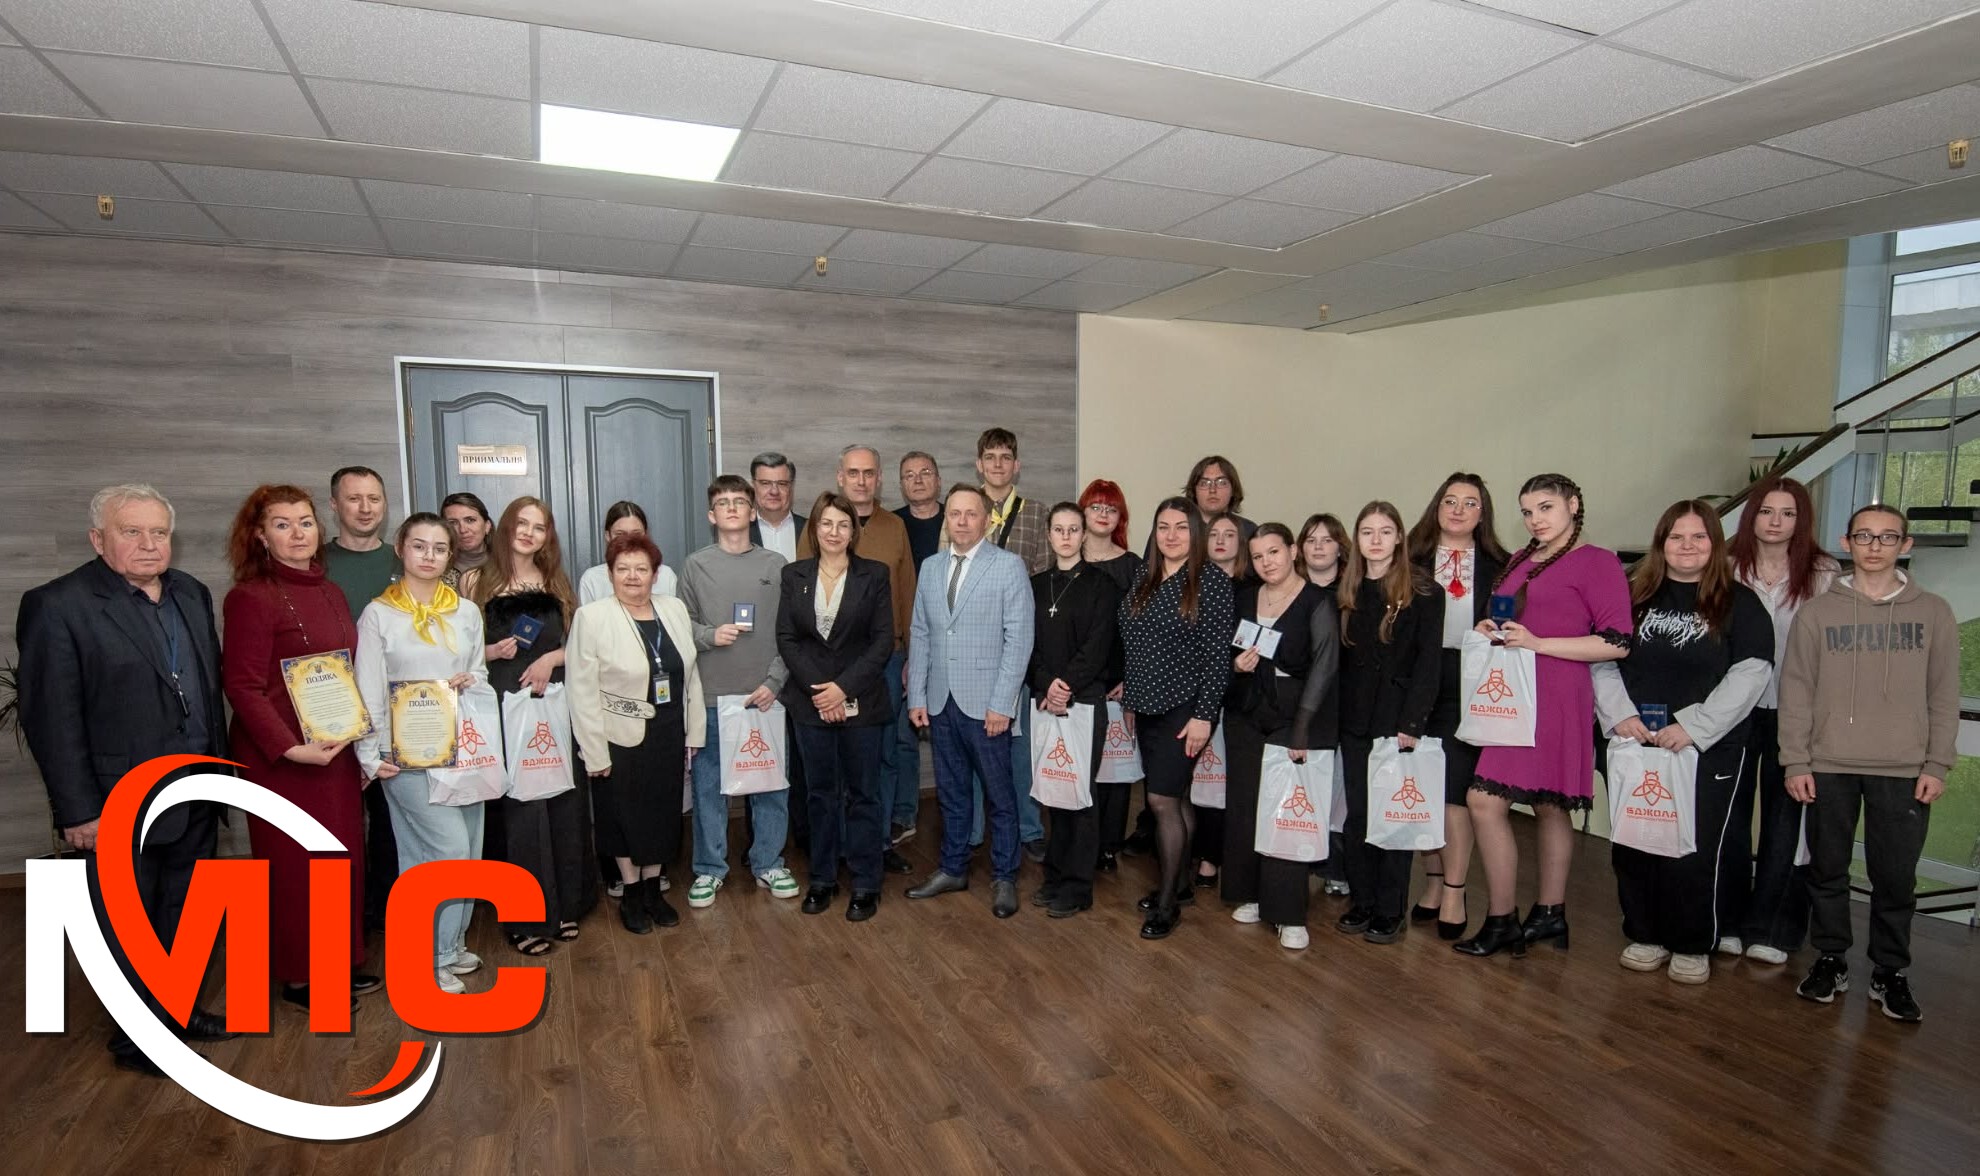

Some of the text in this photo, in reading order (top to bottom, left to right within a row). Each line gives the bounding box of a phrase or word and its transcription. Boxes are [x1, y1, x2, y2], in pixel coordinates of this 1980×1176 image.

[305, 672, 338, 684] ПОДЯКА
[1470, 704, 1518, 716] БДЖОЛА
[455, 756, 497, 768] ДЖОЛА
[521, 758, 563, 767] БДЖОЛА
[1194, 773, 1226, 781] ДЖОЛА
[1385, 811, 1431, 820] БДЖОЛА
[1626, 806, 1678, 819] БДЖОЛА
[1275, 818, 1319, 831] БДЖОЛА
